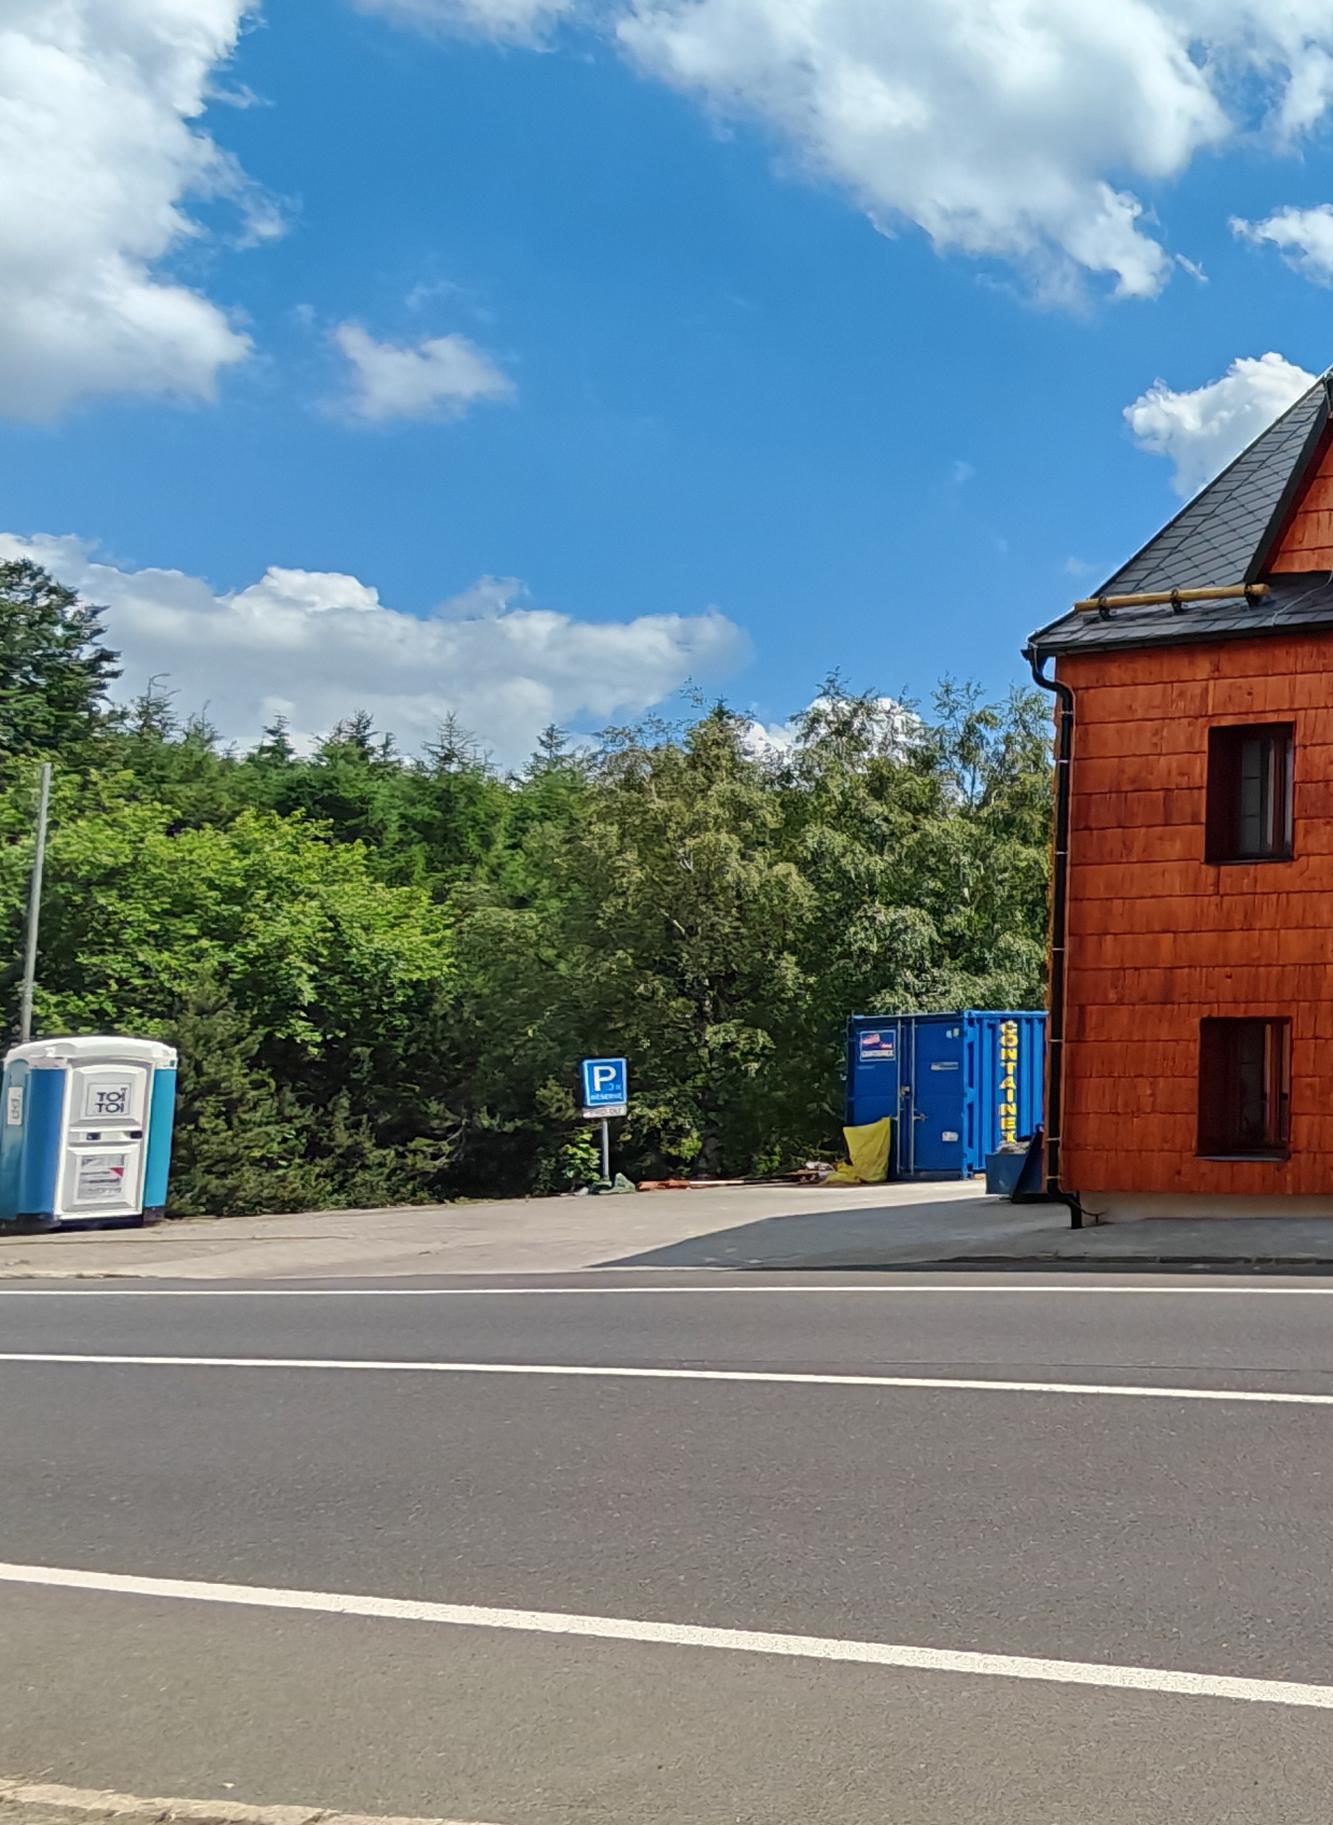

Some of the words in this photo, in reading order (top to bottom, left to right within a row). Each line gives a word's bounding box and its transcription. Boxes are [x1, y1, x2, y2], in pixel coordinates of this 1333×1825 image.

[593, 1065, 617, 1092] P
[96, 1089, 127, 1102] TOI
[96, 1102, 125, 1113] TOI
